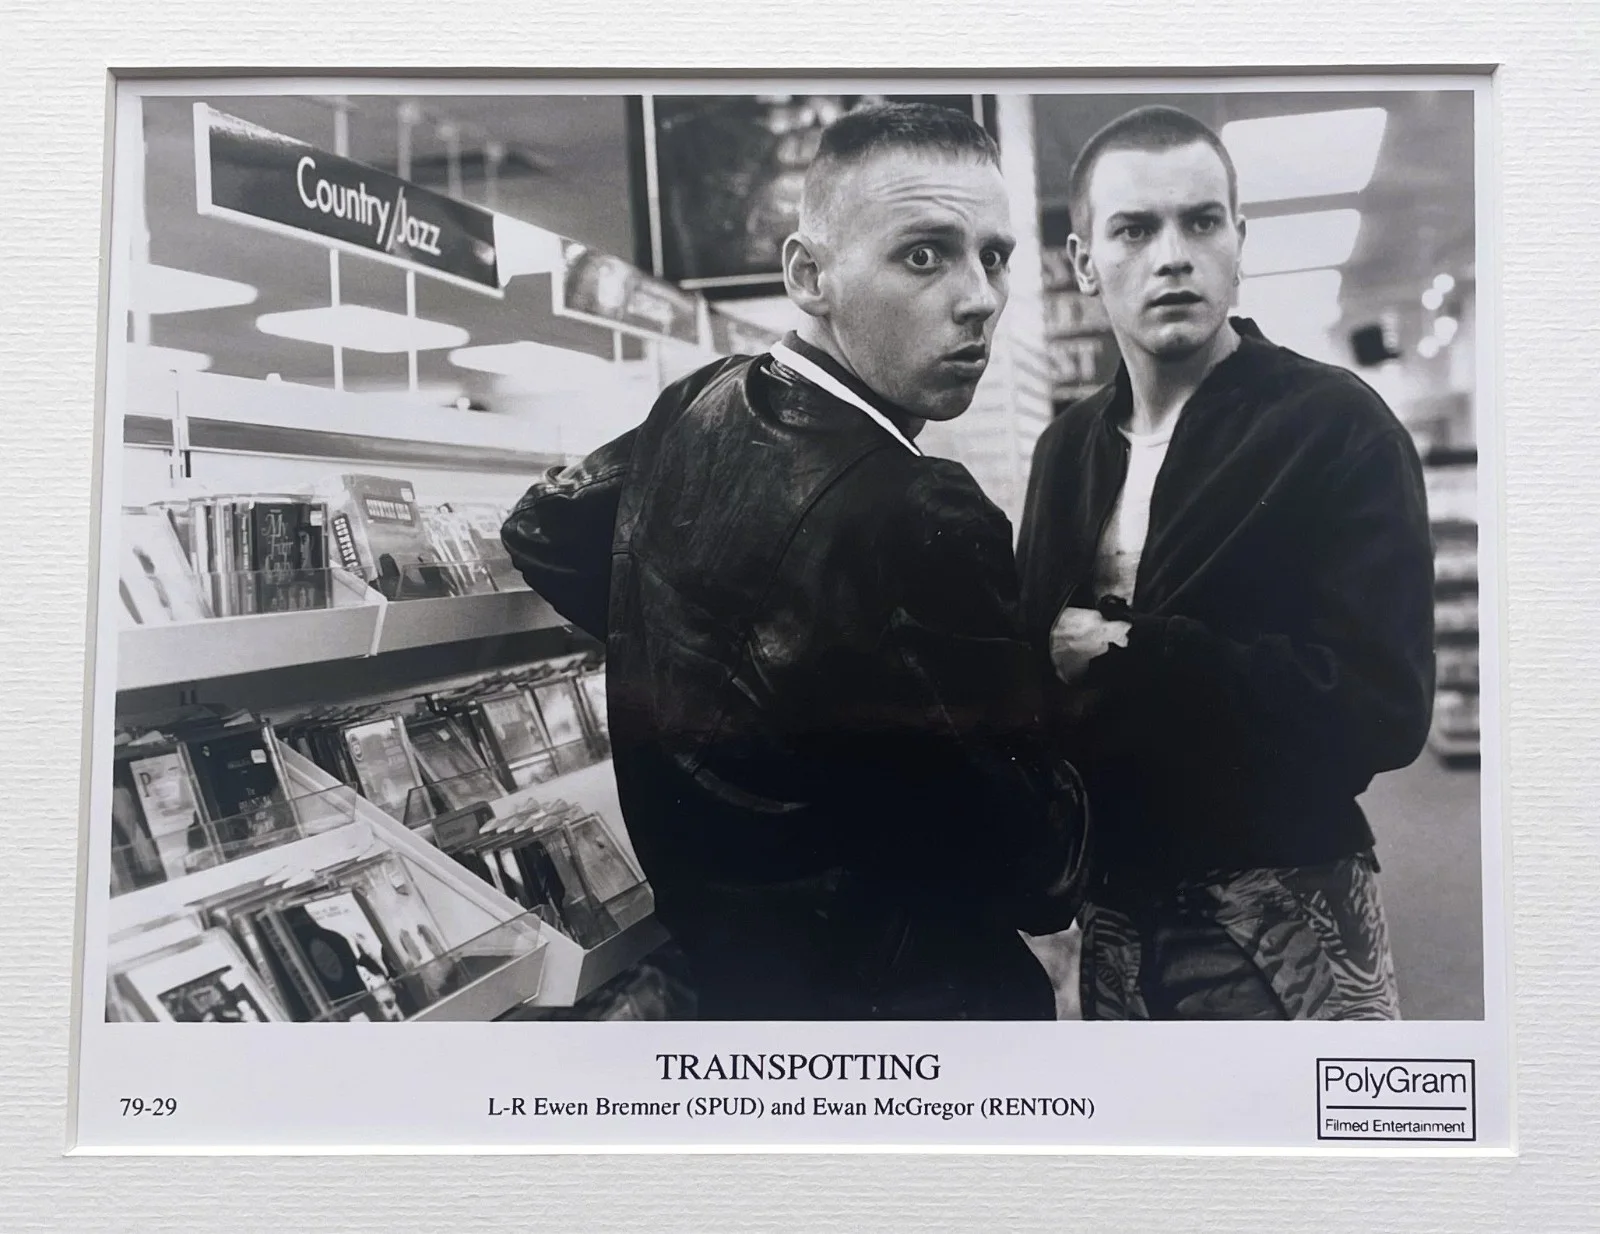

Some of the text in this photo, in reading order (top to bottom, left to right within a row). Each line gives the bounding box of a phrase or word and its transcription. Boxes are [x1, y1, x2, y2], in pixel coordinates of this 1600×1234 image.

[296, 156, 442, 256] Country/Jazz
[261, 513, 289, 537] My
[655, 1053, 942, 1081] TRAINSPOTTING
[1324, 1065, 1467, 1099] PolyGram
[119, 1097, 178, 1117] 79-29
[487, 1096, 1095, 1121] L-R Ewen Bremner (SPUD) and Ewan McGregor (RENTON)
[1325, 1118, 1466, 1134] Filmed Entertainment
